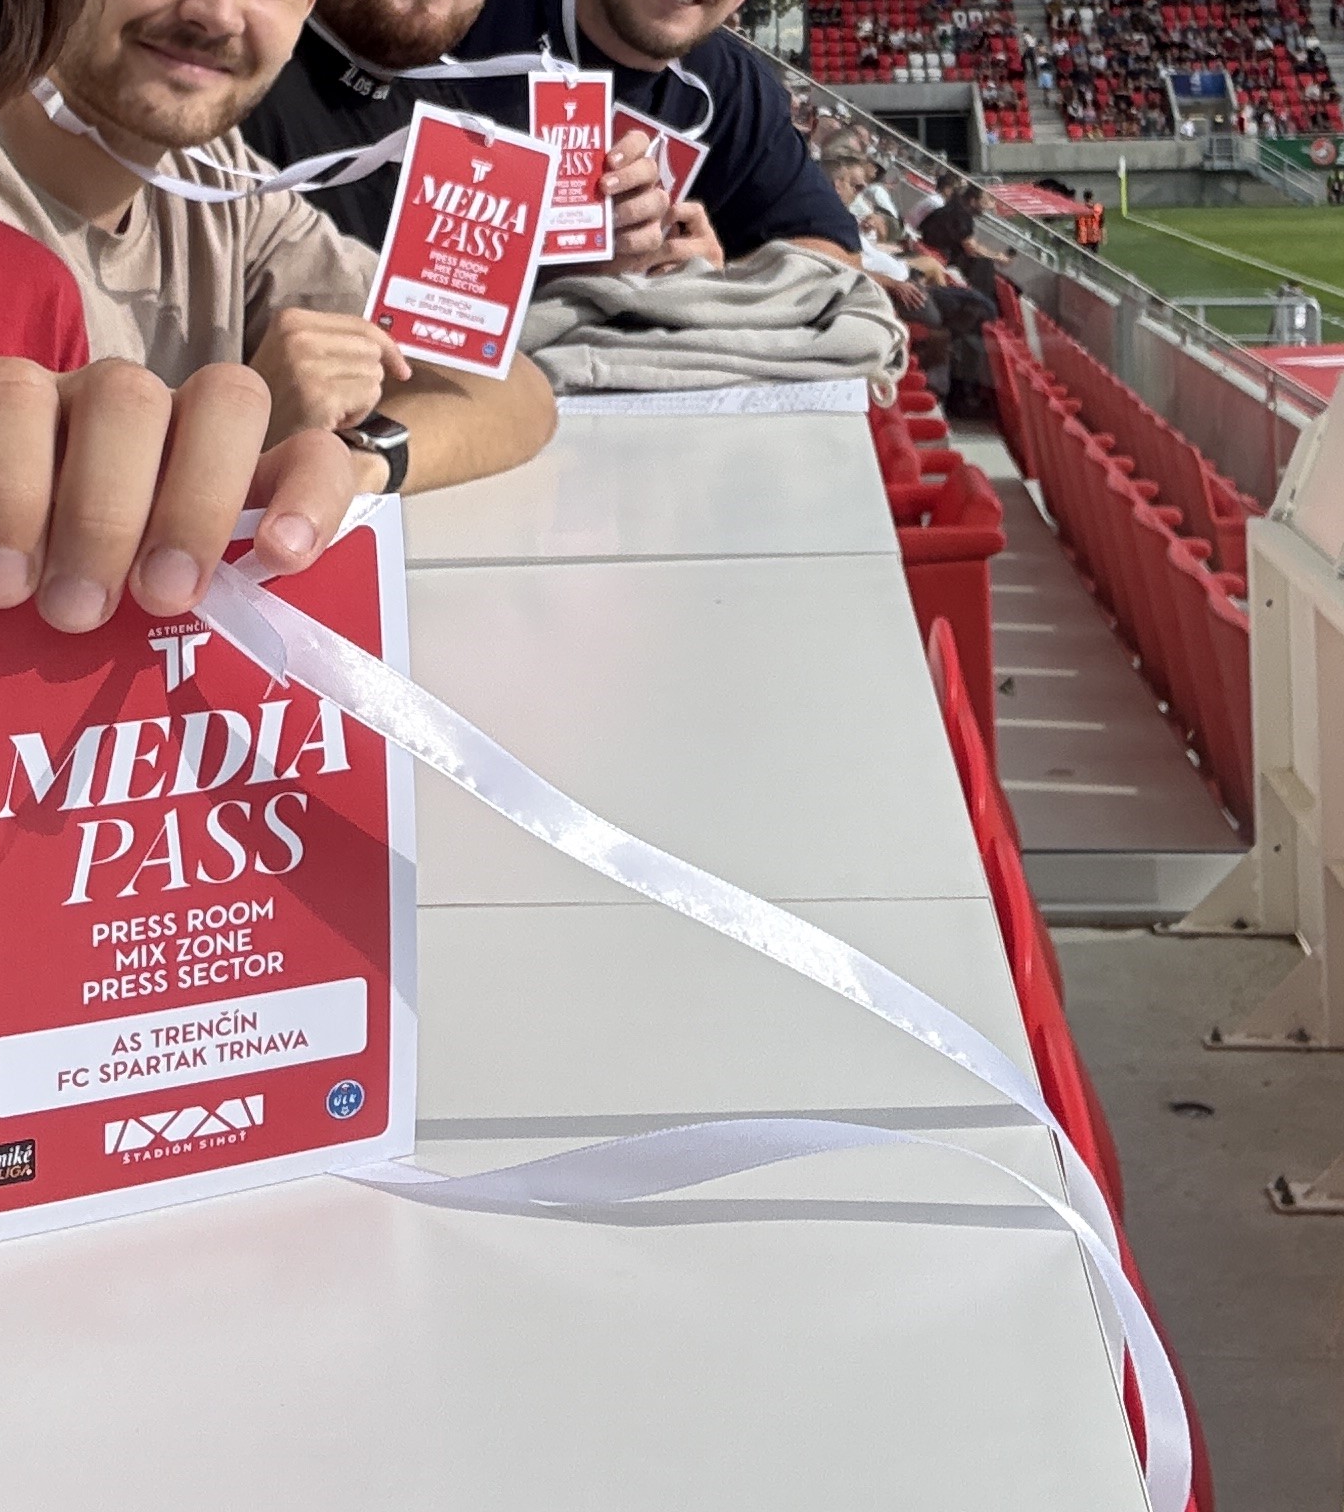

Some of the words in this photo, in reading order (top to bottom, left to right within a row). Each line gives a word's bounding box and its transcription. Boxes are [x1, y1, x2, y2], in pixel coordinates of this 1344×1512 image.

[558, 152, 594, 176] ASS
[412, 174, 527, 236] MEDIA
[425, 214, 510, 262] PASS
[148, 627, 163, 637] AS
[61, 791, 308, 906] PASS
[91, 912, 178, 947] PRESS
[186, 896, 274, 933] ROOM
[115, 942, 167, 972] MIX
[176, 928, 253, 962] ZONE
[82, 970, 168, 1005] PRESS
[177, 951, 284, 989] SECTOR
[111, 1032, 142, 1056] AS
[150, 1009, 258, 1049] TRENČÍN
[57, 1068, 90, 1092] FC
[99, 1047, 207, 1084] SPARTAK
[216, 1030, 309, 1064] TRNAVA
